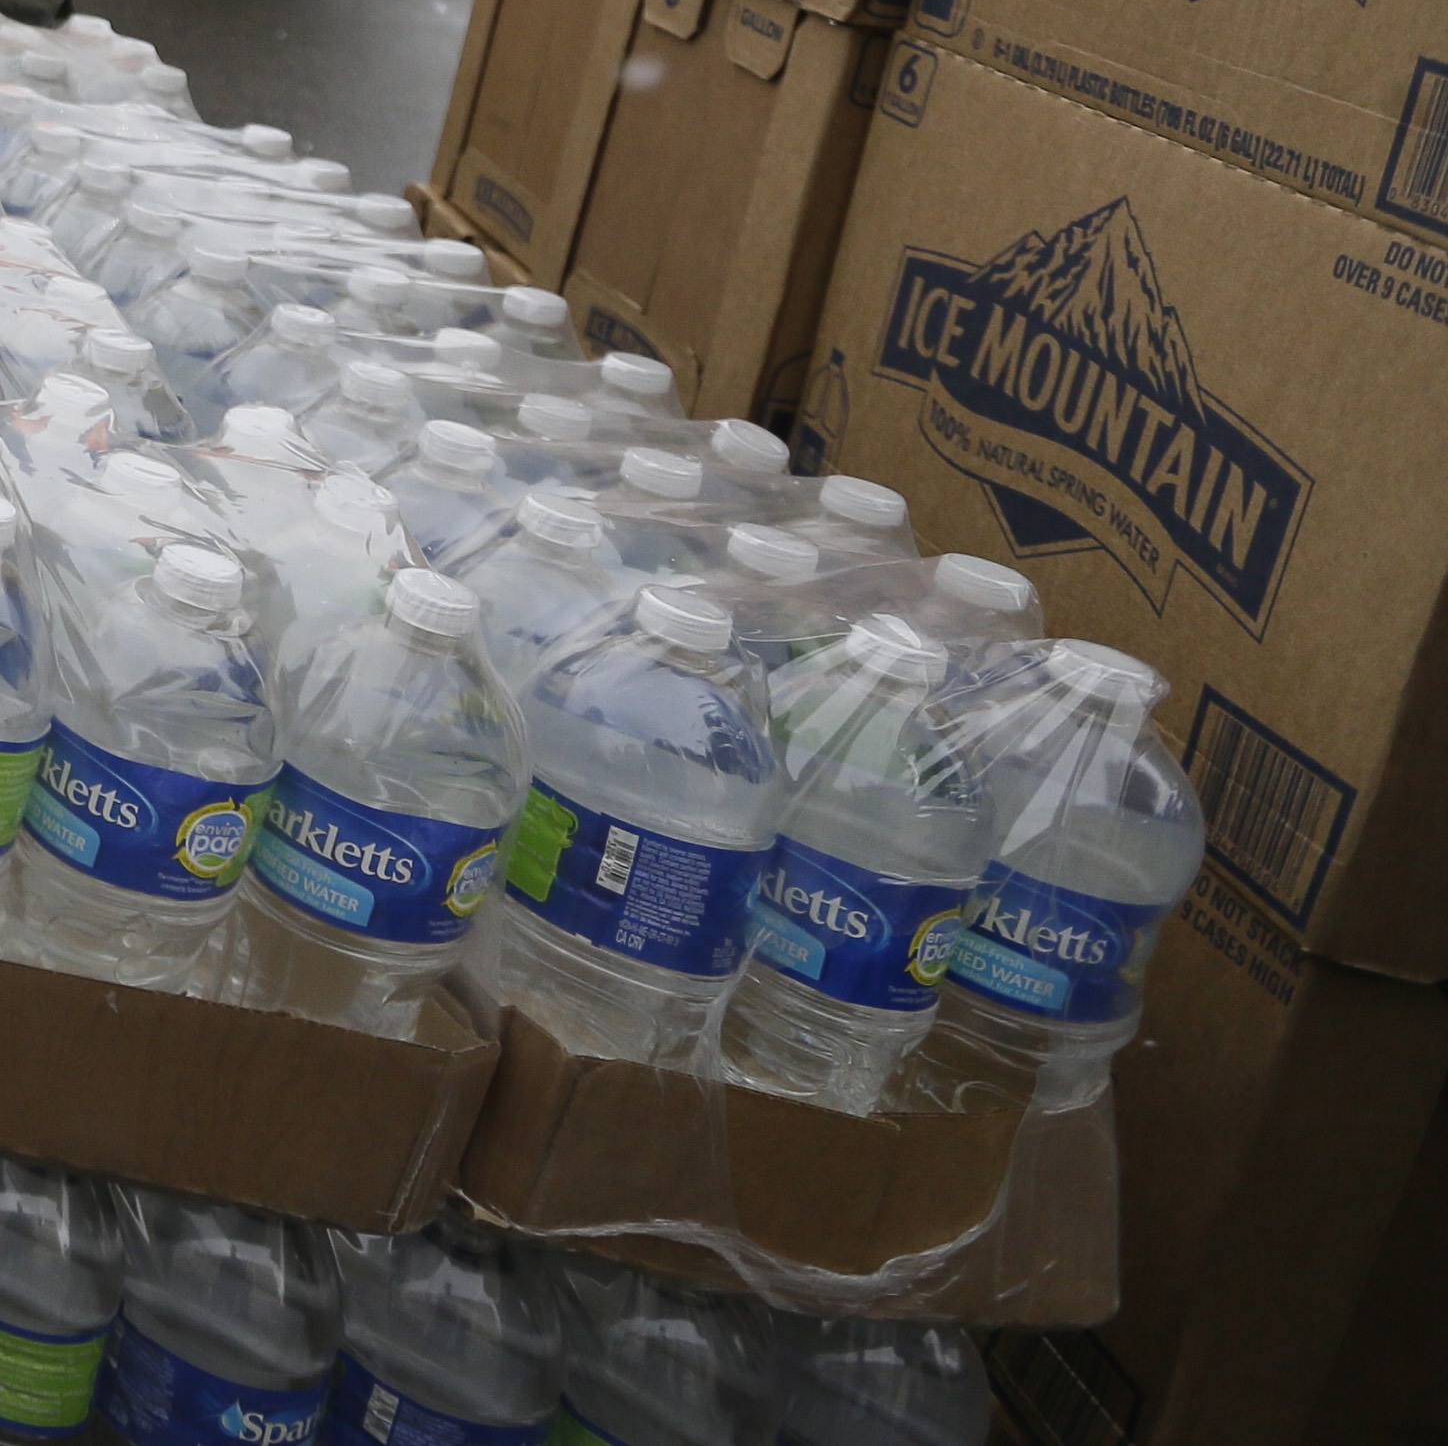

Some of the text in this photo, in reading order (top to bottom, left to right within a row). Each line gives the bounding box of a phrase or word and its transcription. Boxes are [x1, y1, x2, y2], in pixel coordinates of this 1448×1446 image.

[741, 8, 785, 43] GALLON
[899, 54, 920, 95] 6
[1319, 161, 1366, 207] TOTAL)
[1333, 254, 1381, 295] OVER
[1380, 275, 1395, 301] 9
[1384, 241, 1448, 289] DO NO
[897, 276, 1268, 573] ICE MOUNTAIN
[929, 397, 1161, 574] 100% NATURAL SPRING WATER
[42, 745, 140, 830] kletts
[41, 815, 88, 852] WATER
[267, 799, 414, 885] arkletts
[304, 874, 360, 913] WATER
[760, 868, 869, 939] kletts
[615, 929, 628, 944] CA
[627, 933, 646, 951] CRV
[980, 896, 1108, 965] kletts
[1211, 878, 1248, 924] NOT
[1247, 918, 1304, 978] STACK
[1180, 903, 1294, 1007] 9 CASES HIGH
[991, 964, 1054, 997] WATER
